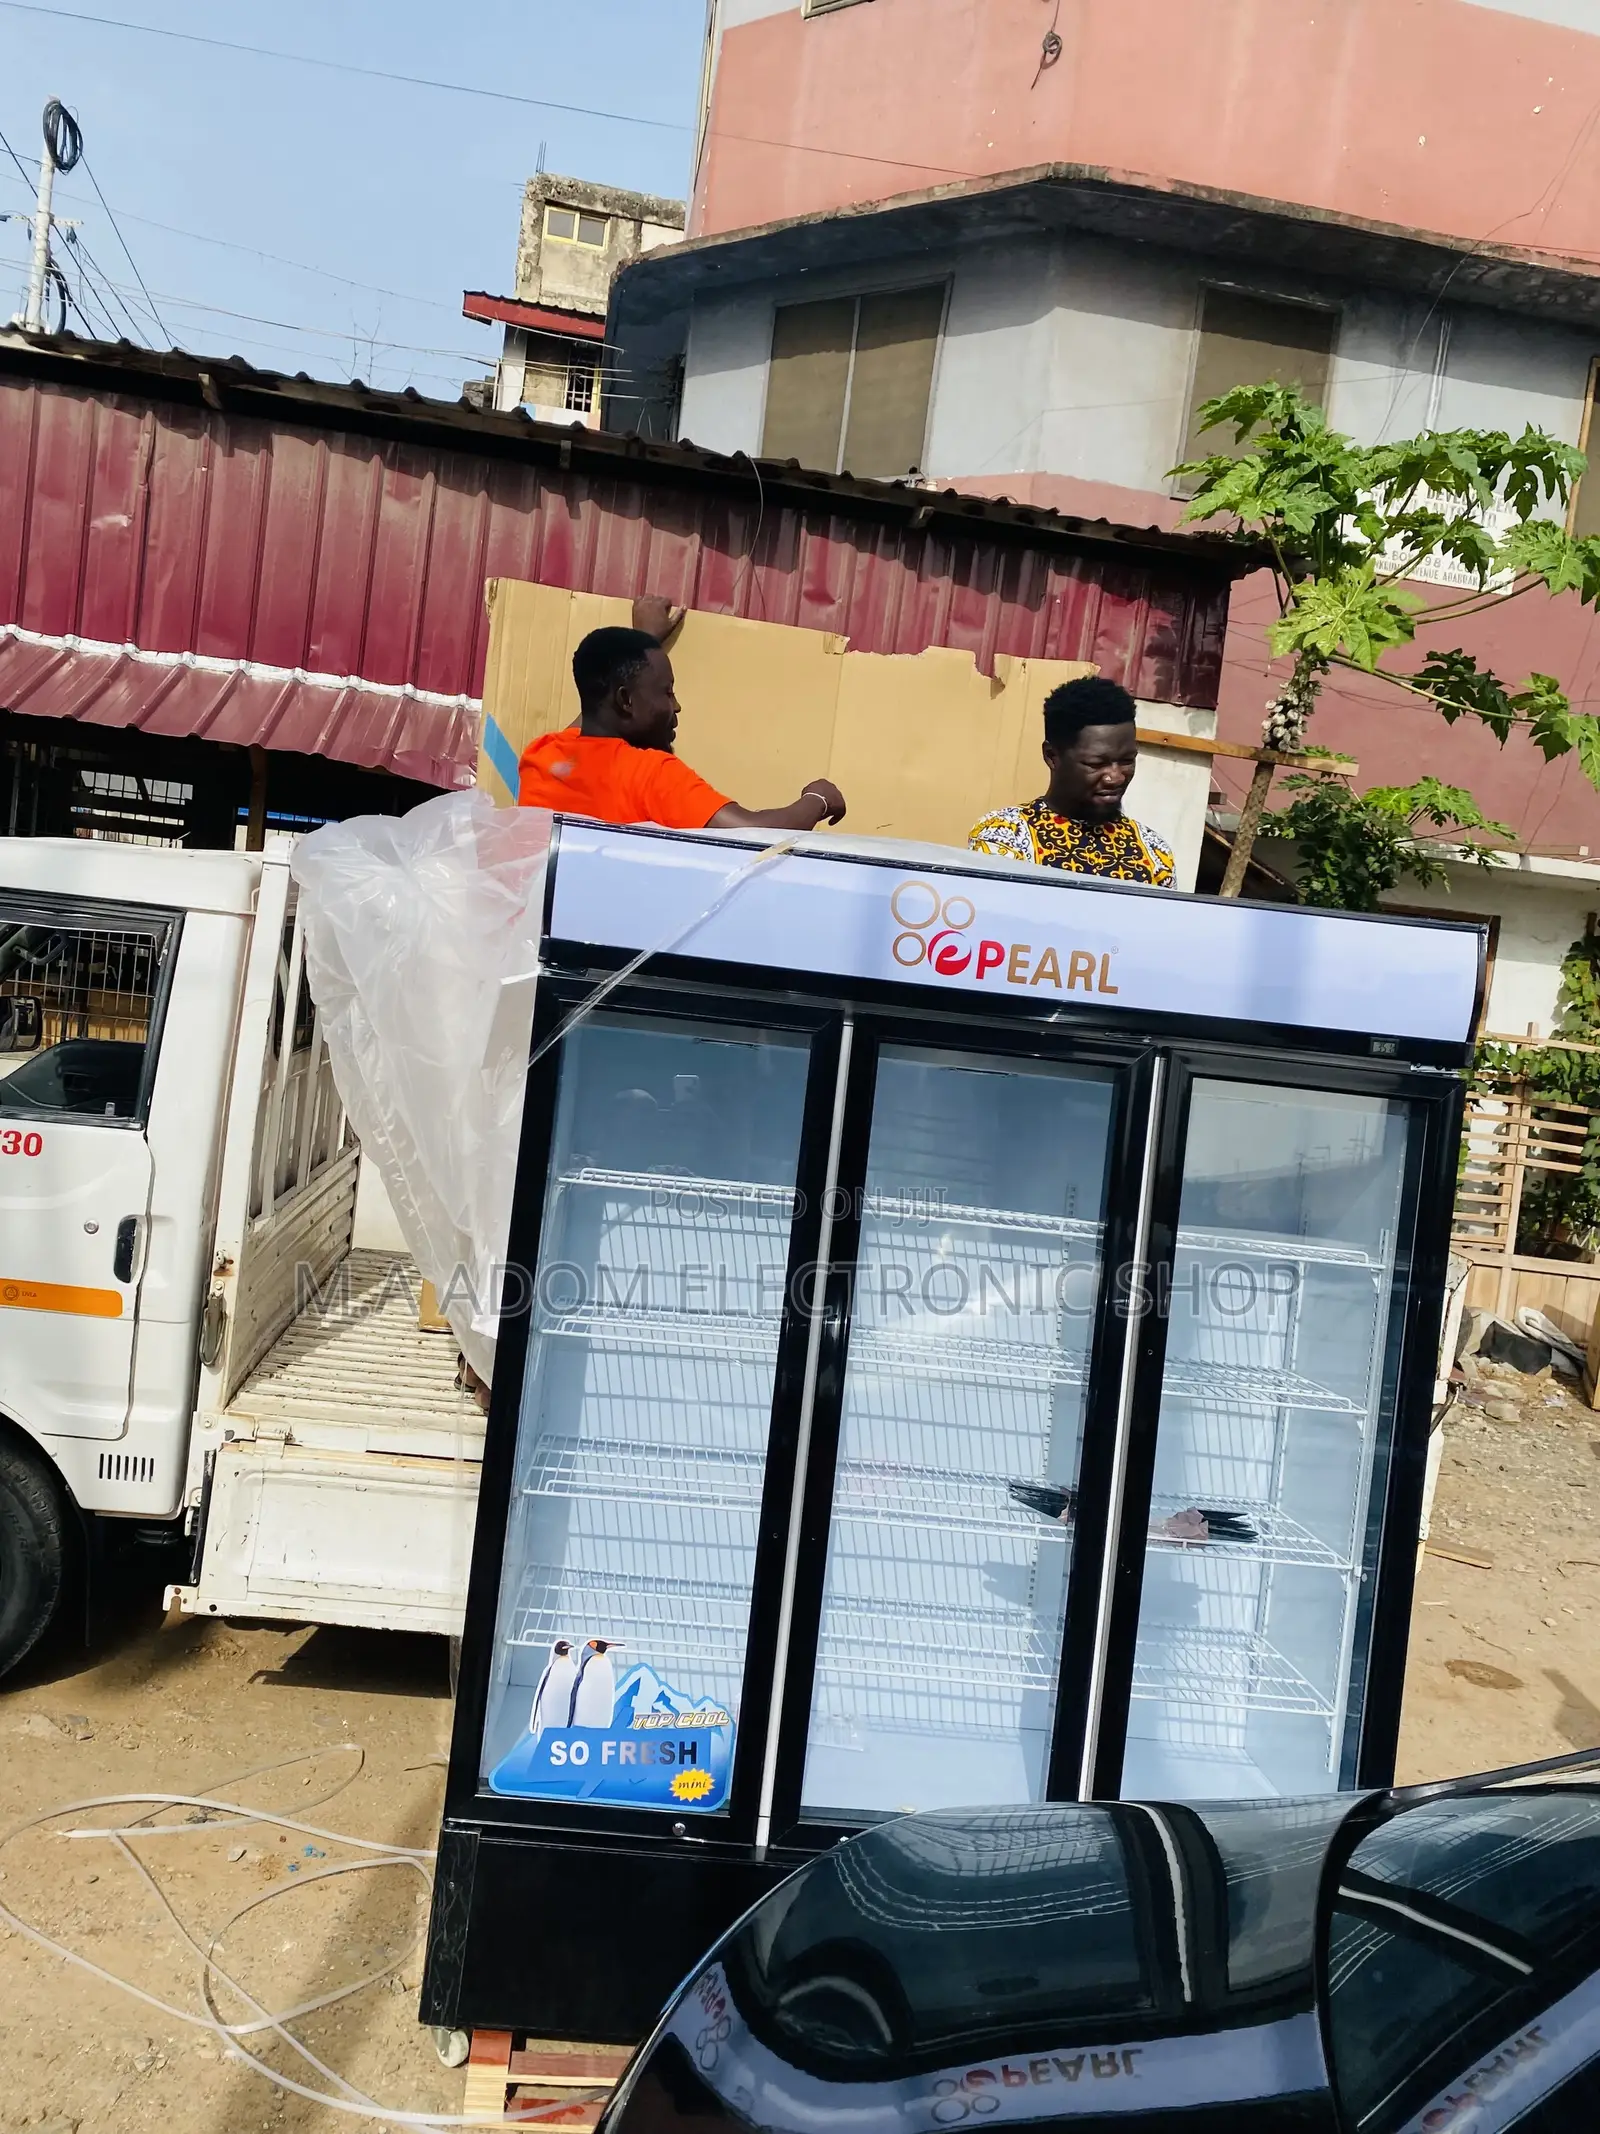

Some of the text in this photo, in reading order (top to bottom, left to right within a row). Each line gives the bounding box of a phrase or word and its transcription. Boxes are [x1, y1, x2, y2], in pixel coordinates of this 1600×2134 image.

[975, 939, 1119, 995] PEARL
[0, 1129, 43, 1157] 30
[632, 1711, 731, 1730] TOP COOL
[550, 1740, 698, 1766] SO FRESH
[678, 1777, 709, 1790] mini
